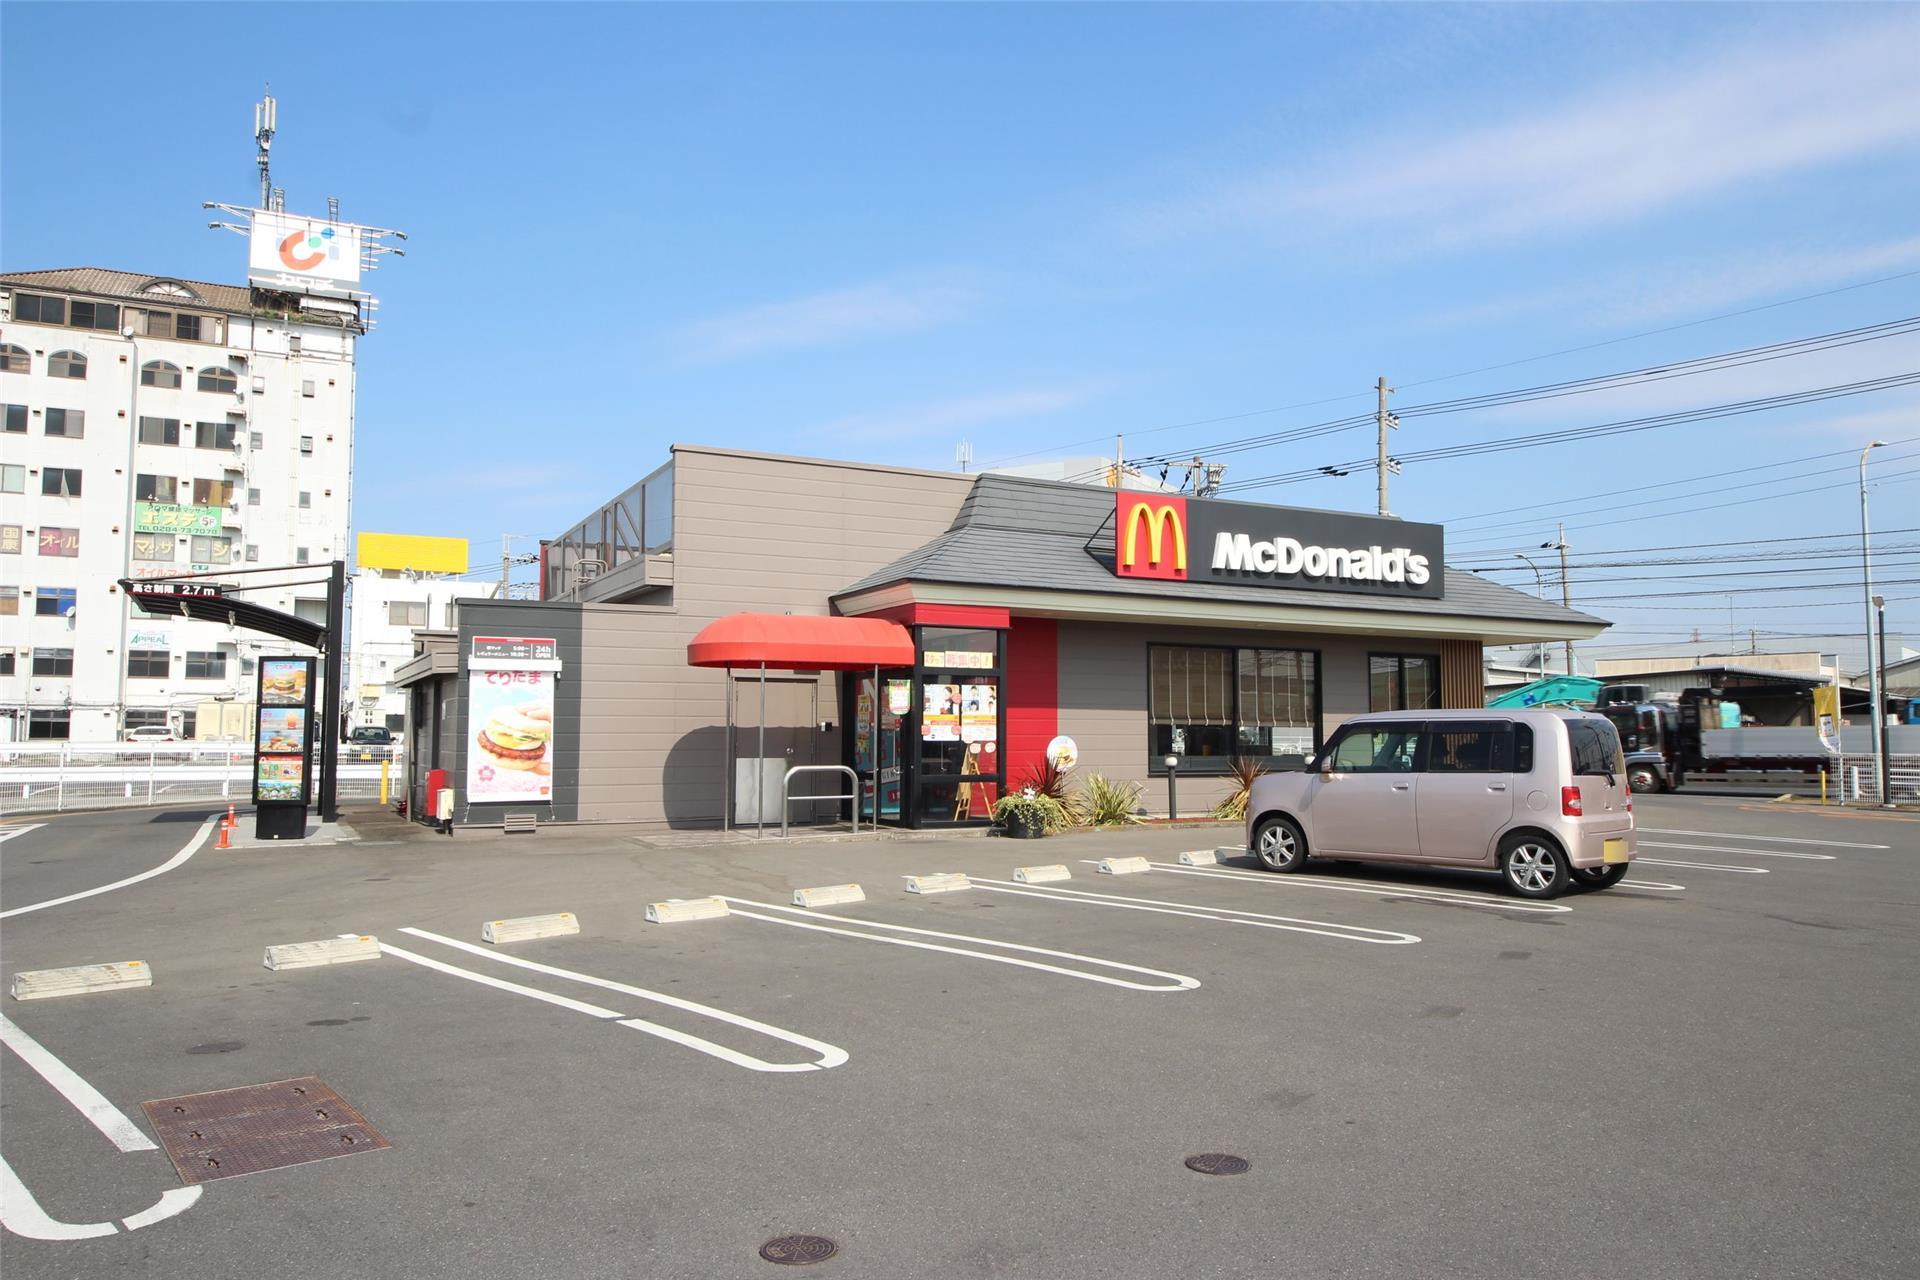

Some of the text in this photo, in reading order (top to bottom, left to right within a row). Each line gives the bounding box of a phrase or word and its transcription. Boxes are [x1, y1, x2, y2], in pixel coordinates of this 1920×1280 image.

[143, 511, 215, 527] エステ 5F
[40, 534, 79, 548] オイル
[1211, 531, 1430, 585] McDonald's
[132, 583, 215, 596] 高さ制限 2.7 m
[485, 670, 541, 685] てりたま
